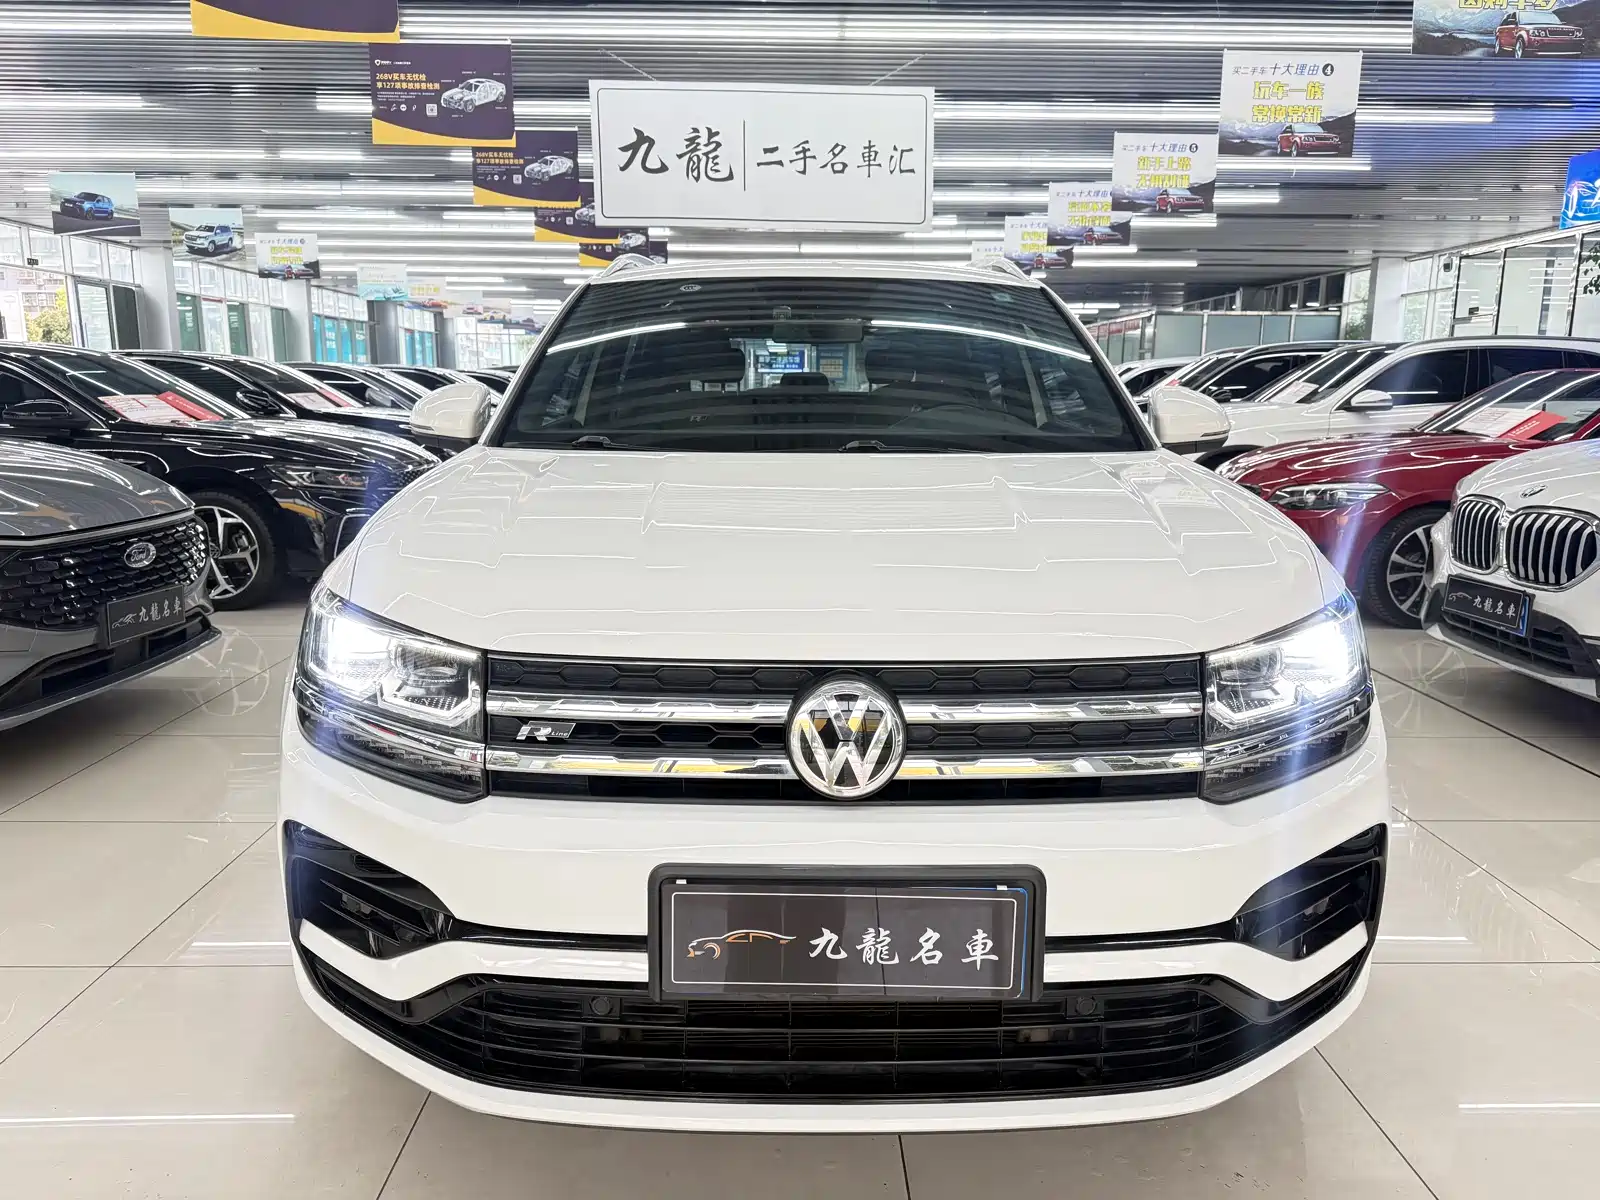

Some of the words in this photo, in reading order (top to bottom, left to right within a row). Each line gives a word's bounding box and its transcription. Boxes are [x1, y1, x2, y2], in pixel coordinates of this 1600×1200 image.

[1253, 81, 1325, 100] 玩车一族
[1252, 104, 1323, 123] 常换常新
[617, 126, 734, 183] 九龍
[756, 139, 916, 178] 二手名車汇
[130, 547, 148, 562] Ford
[139, 596, 182, 622] 九龍名車
[1472, 595, 1516, 619] 九龍名車
[516, 725, 552, 741] R
[808, 927, 999, 971] 九龍名車
